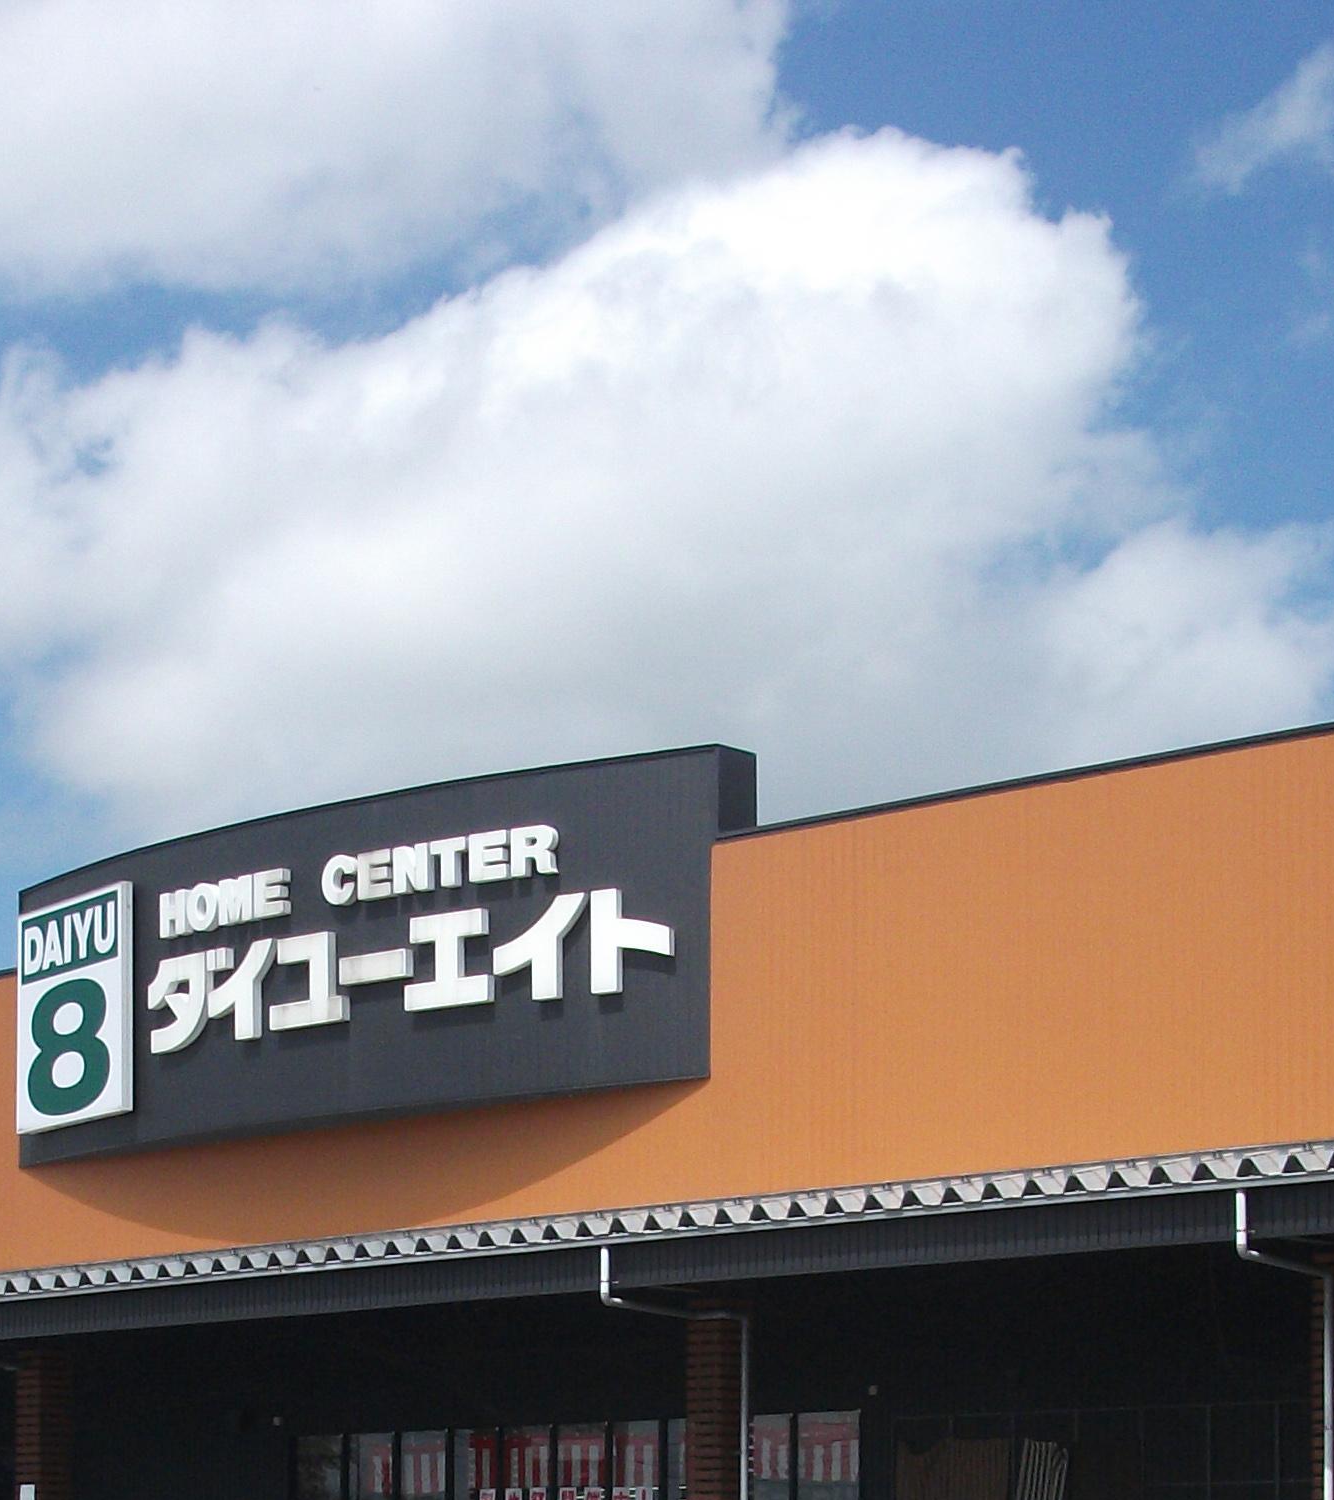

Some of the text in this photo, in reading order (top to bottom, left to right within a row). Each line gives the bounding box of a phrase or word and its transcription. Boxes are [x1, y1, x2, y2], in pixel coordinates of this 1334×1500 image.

[23, 898, 117, 977] DAIYU
[159, 824, 559, 939] HOME CENTER
[148, 888, 675, 1054] ダイユーエイト
[27, 977, 111, 1117] 8
